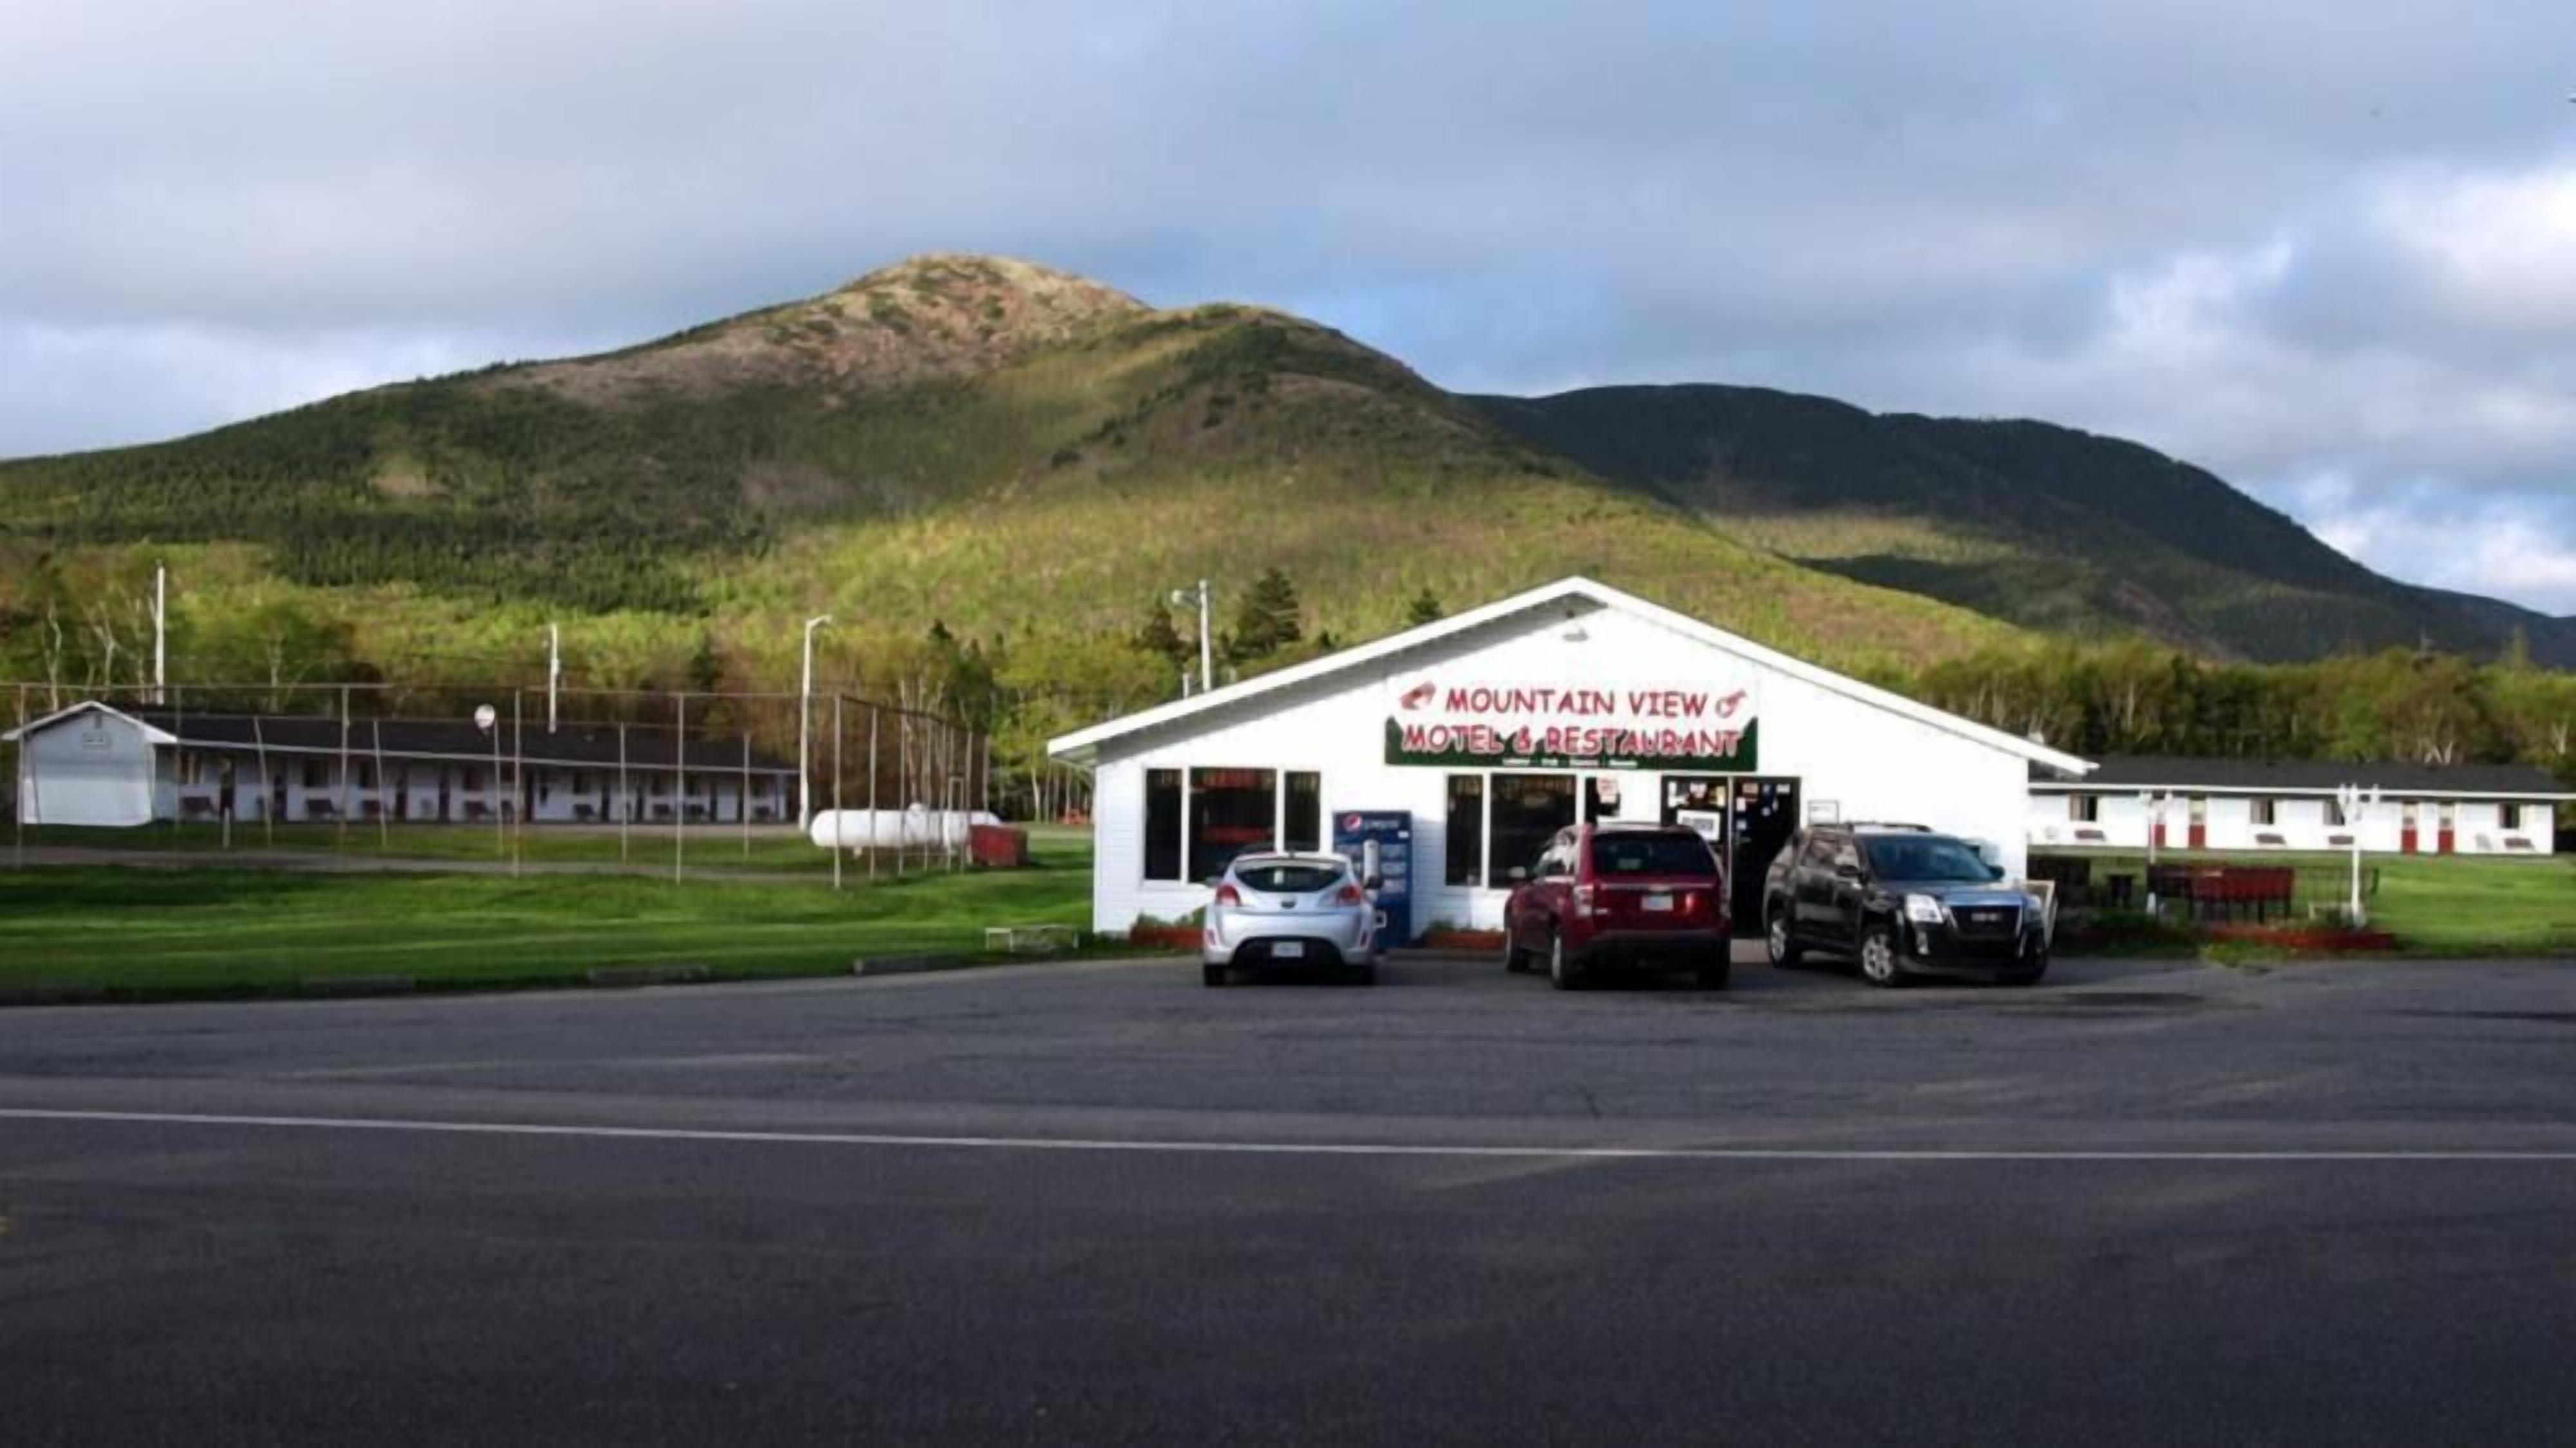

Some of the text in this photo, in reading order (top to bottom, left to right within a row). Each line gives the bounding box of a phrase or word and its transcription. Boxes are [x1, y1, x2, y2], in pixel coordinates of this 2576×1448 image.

[1445, 687, 1708, 717] MOUNTAIN VIEW
[1401, 723, 1741, 757] MOTEL & RESTAURANT
